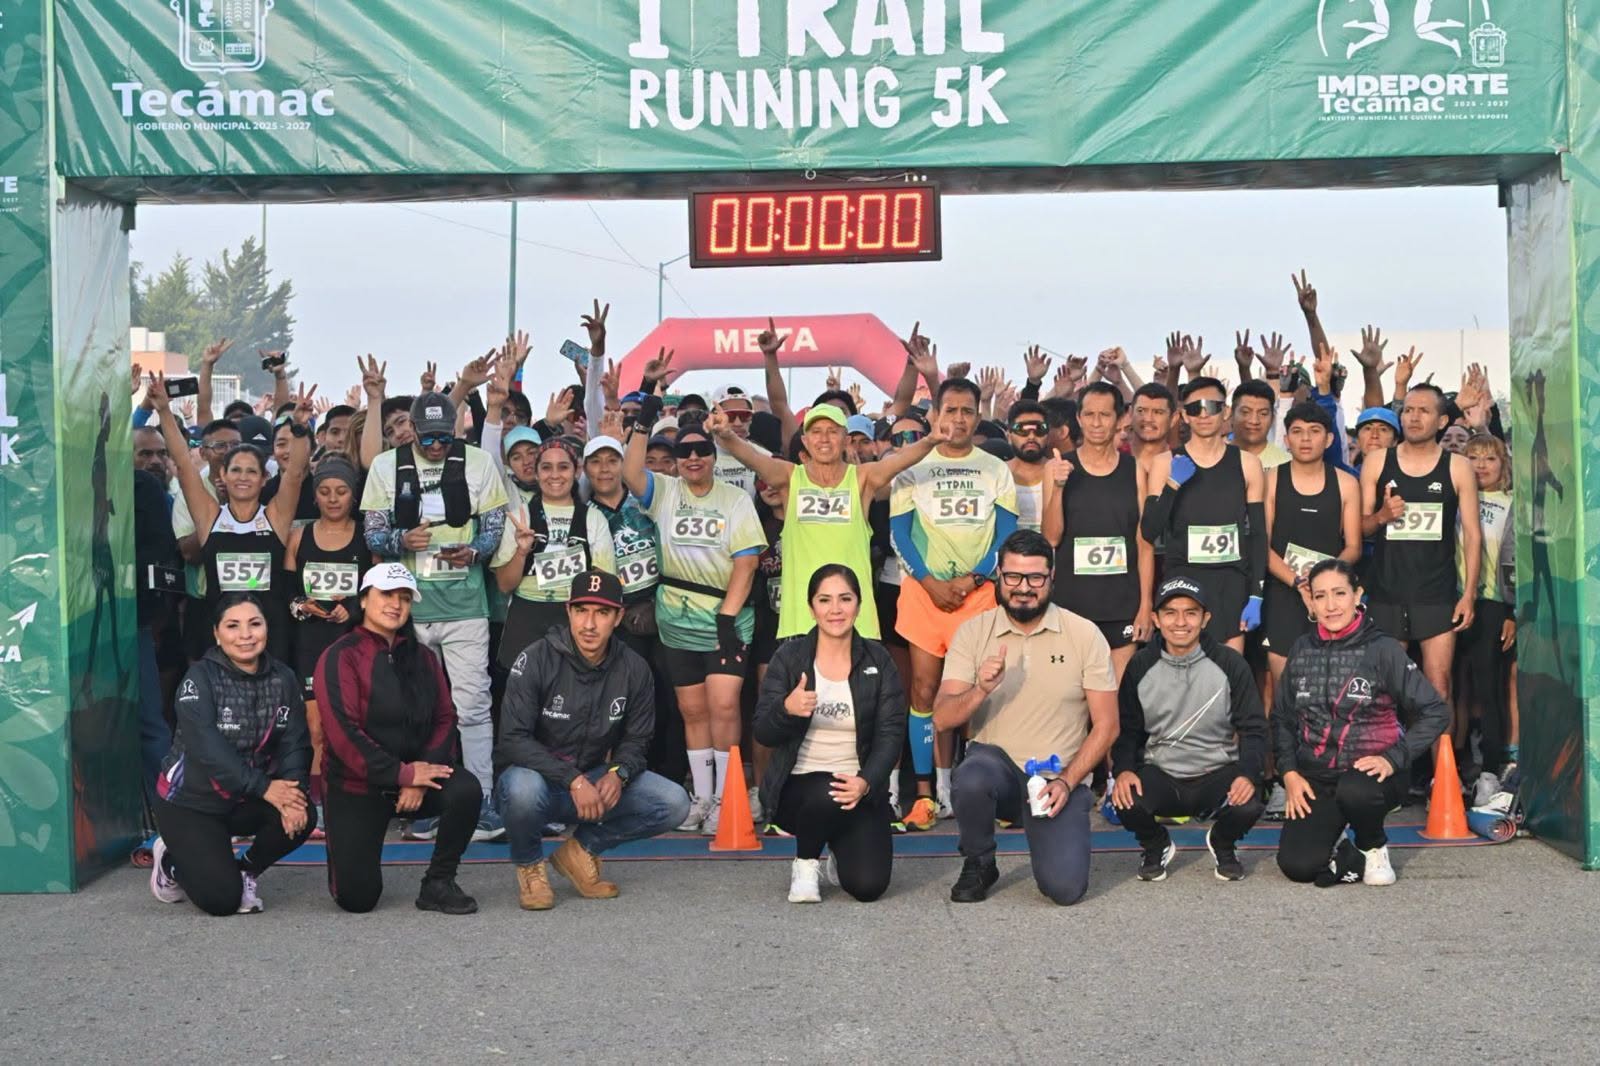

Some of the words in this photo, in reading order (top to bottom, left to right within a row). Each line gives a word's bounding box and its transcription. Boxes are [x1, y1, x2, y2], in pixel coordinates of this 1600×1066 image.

[1318, 73, 1508, 96] IMDEPORTE
[112, 81, 335, 117] Tecámac
[629, 66, 901, 130] RUNNING
[931, 65, 1009, 127] 5K
[1318, 91, 1445, 113] Tecámac
[137, 122, 192, 131] GOBIERNO
[194, 122, 251, 131] MUNICIPAL
[252, 122, 277, 130] 2025
[287, 122, 311, 130] 2027
[710, 193, 921, 253] 00:00:00
[714, 327, 819, 353] META
[801, 496, 845, 515] 234
[940, 498, 979, 517] 561
[675, 518, 721, 538] 630
[1201, 535, 1229, 554] 49
[1088, 546, 1116, 566] 67
[223, 563, 265, 582] 557
[541, 554, 585, 580] 643
[618, 556, 659, 584] 196
[310, 572, 354, 591] 295
[588, 575, 601, 592] B
